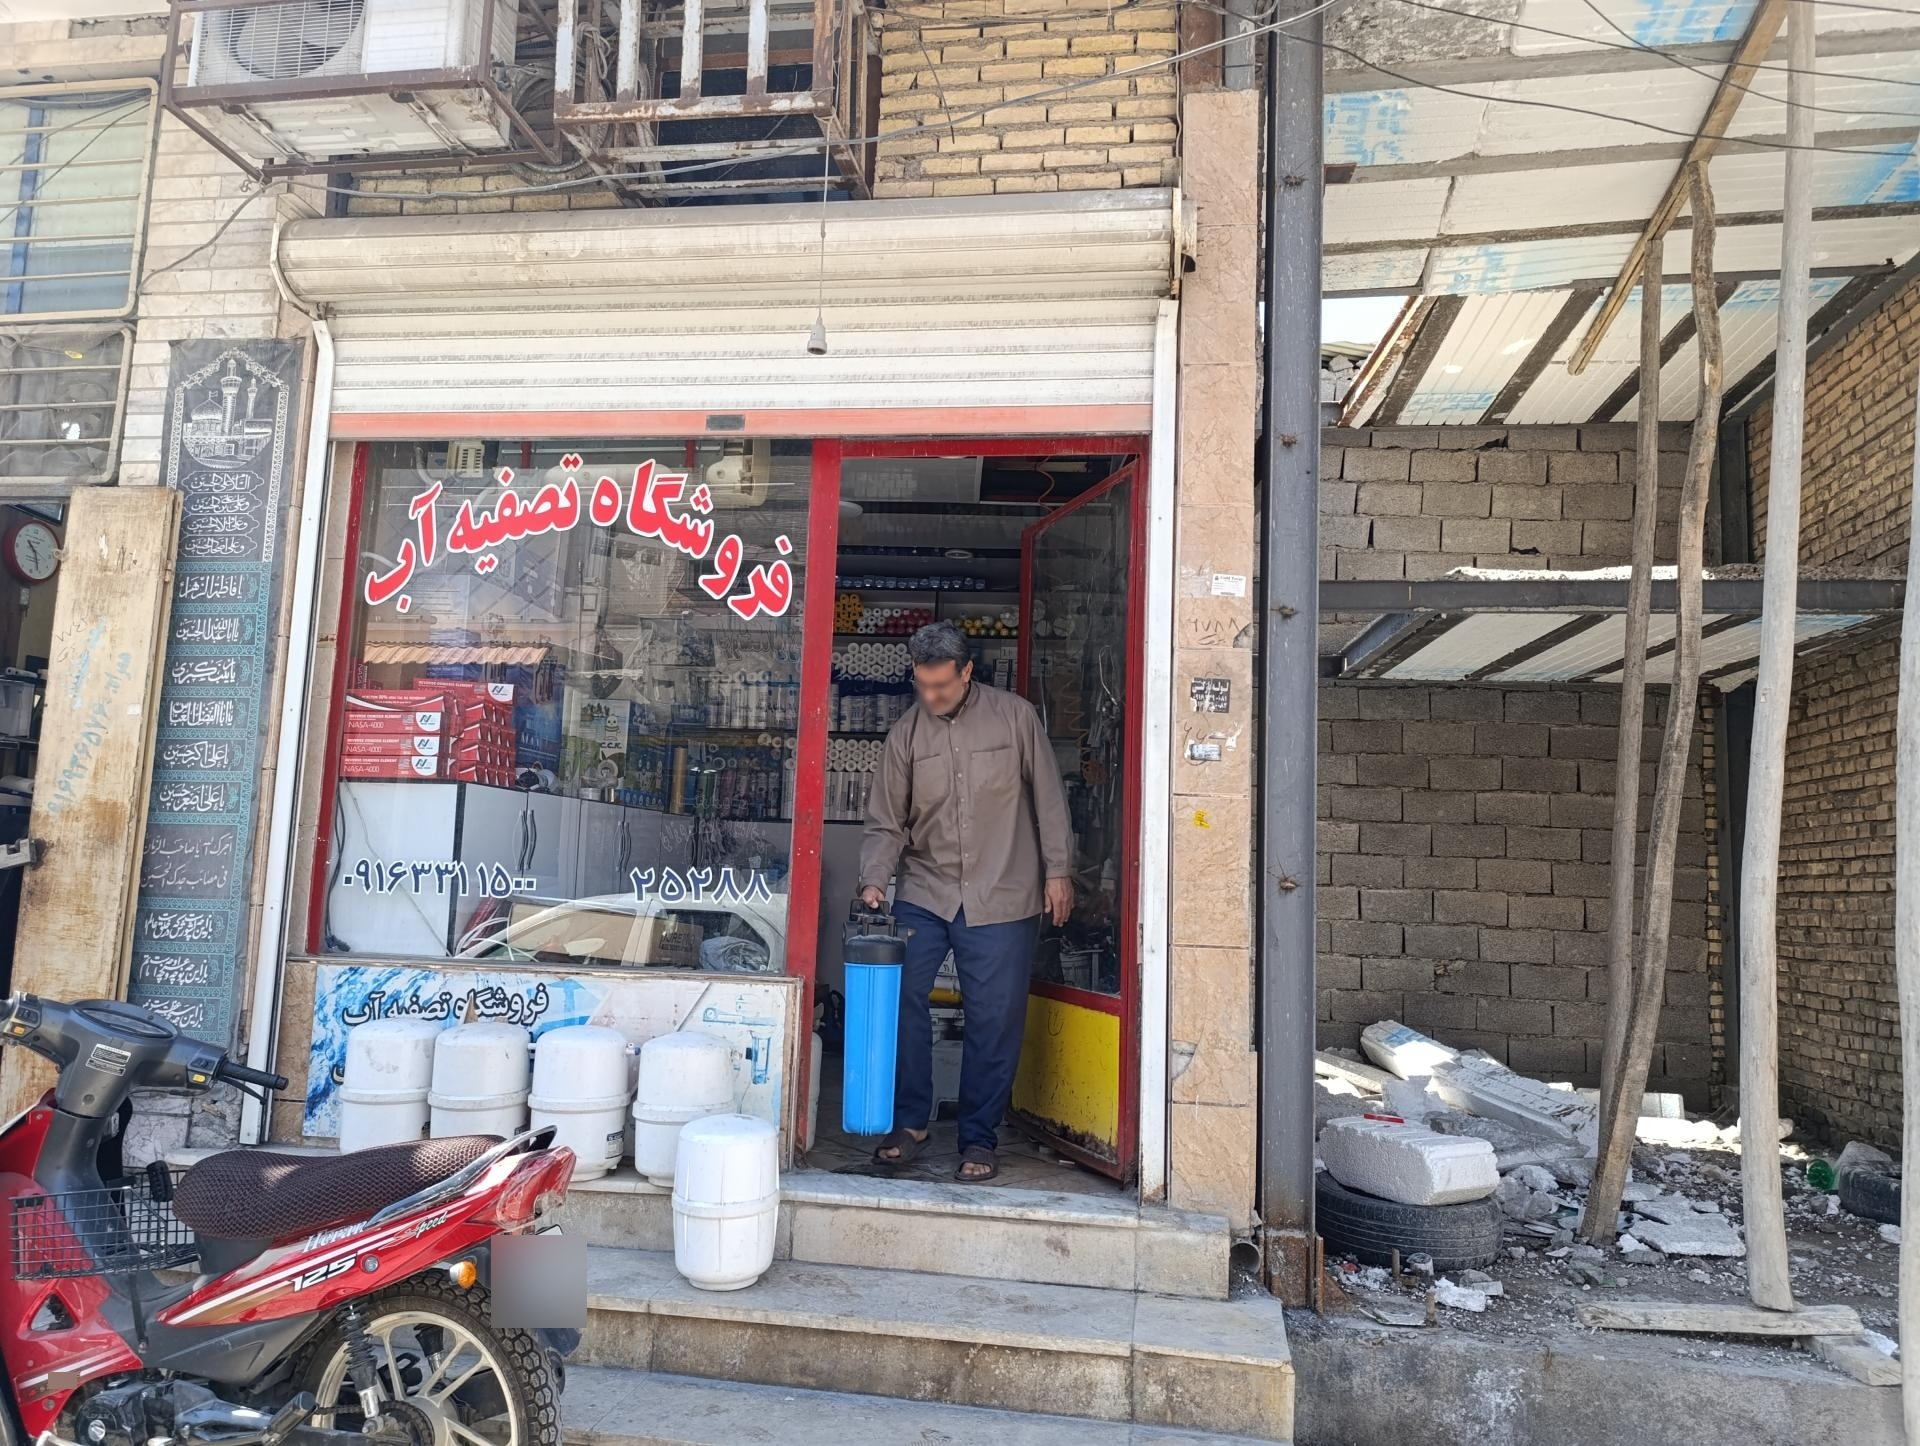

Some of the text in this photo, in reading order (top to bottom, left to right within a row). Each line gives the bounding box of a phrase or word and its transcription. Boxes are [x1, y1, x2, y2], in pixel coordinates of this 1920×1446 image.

[364, 453, 794, 621] فروشگاه تصفیه آب
[348, 721, 385, 729] NASA-4000
[630, 866, 773, 904] ۲۵۲۸۸
[385, 1210, 449, 1245] Speed
[292, 1252, 358, 1293] 125
